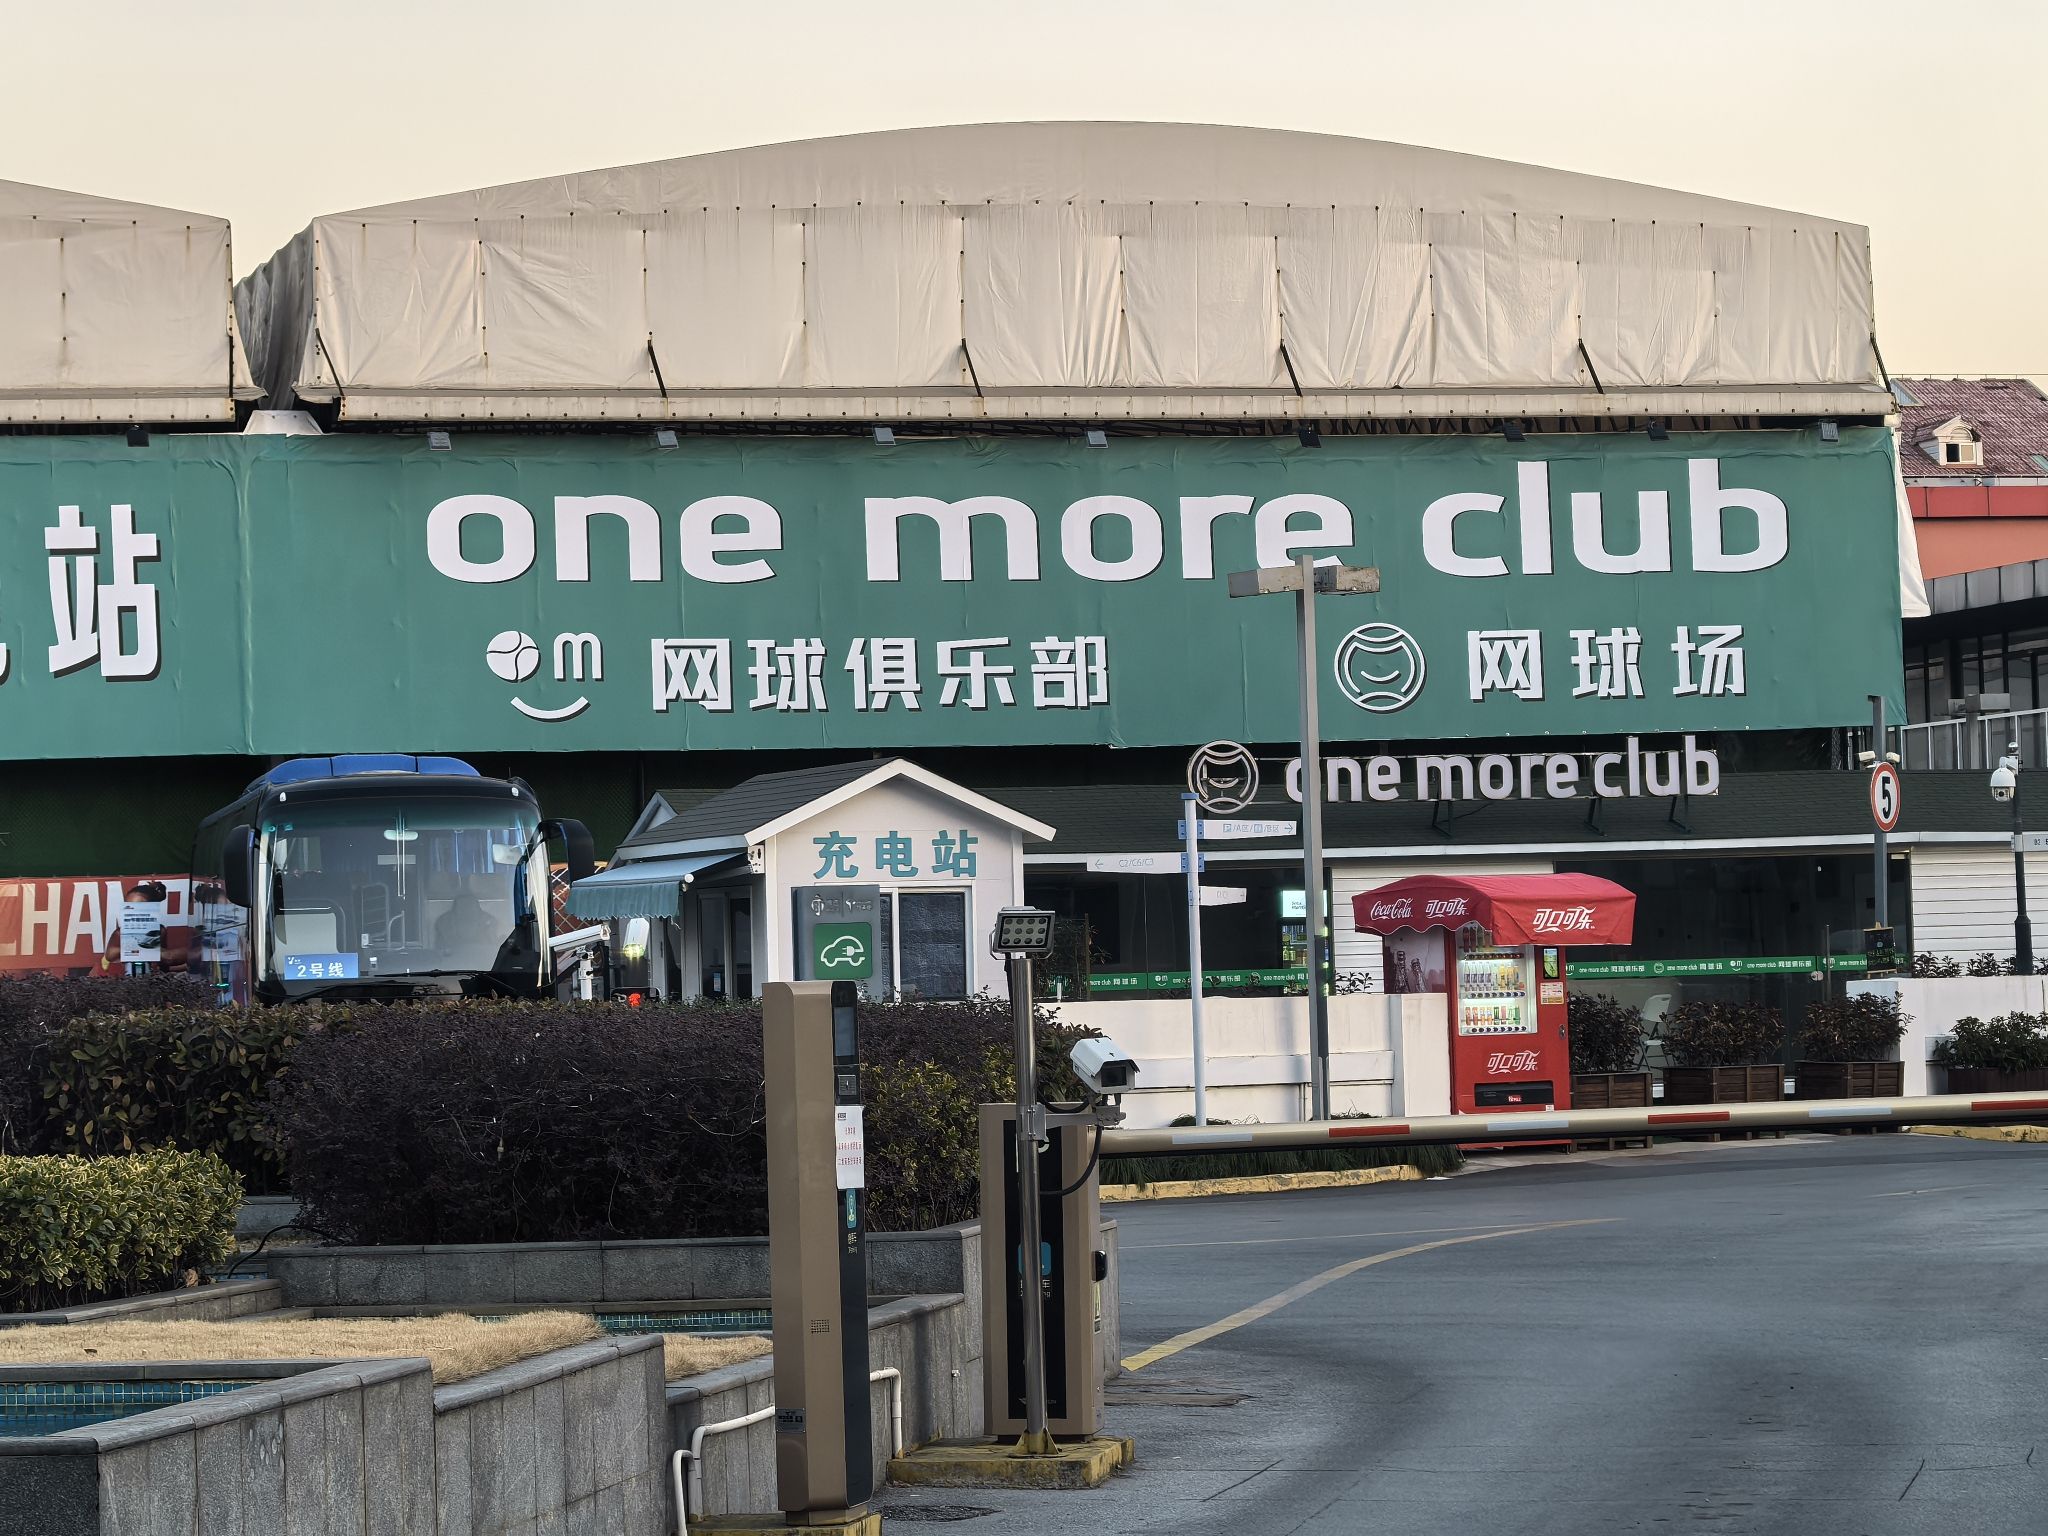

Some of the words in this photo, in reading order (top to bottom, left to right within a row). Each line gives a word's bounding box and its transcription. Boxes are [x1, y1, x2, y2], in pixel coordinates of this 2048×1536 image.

[427, 493, 783, 584] one
[864, 492, 1354, 582] more
[1422, 458, 1789, 577] club
[650, 634, 1109, 712] 网球俱乐部
[1467, 624, 1747, 701] 网球场
[1416, 754, 1577, 800] more
[1595, 735, 1720, 798] club
[1881, 775, 1892, 820] 5
[812, 829, 979, 880] 充电站
[1370, 898, 1413, 921] Coca-Cola
[1425, 897, 1470, 918] 可口可乐
[1532, 905, 1596, 933] 可口可乐
[297, 962, 345, 978] 2号线
[1487, 1049, 1540, 1075] 可口可乐
